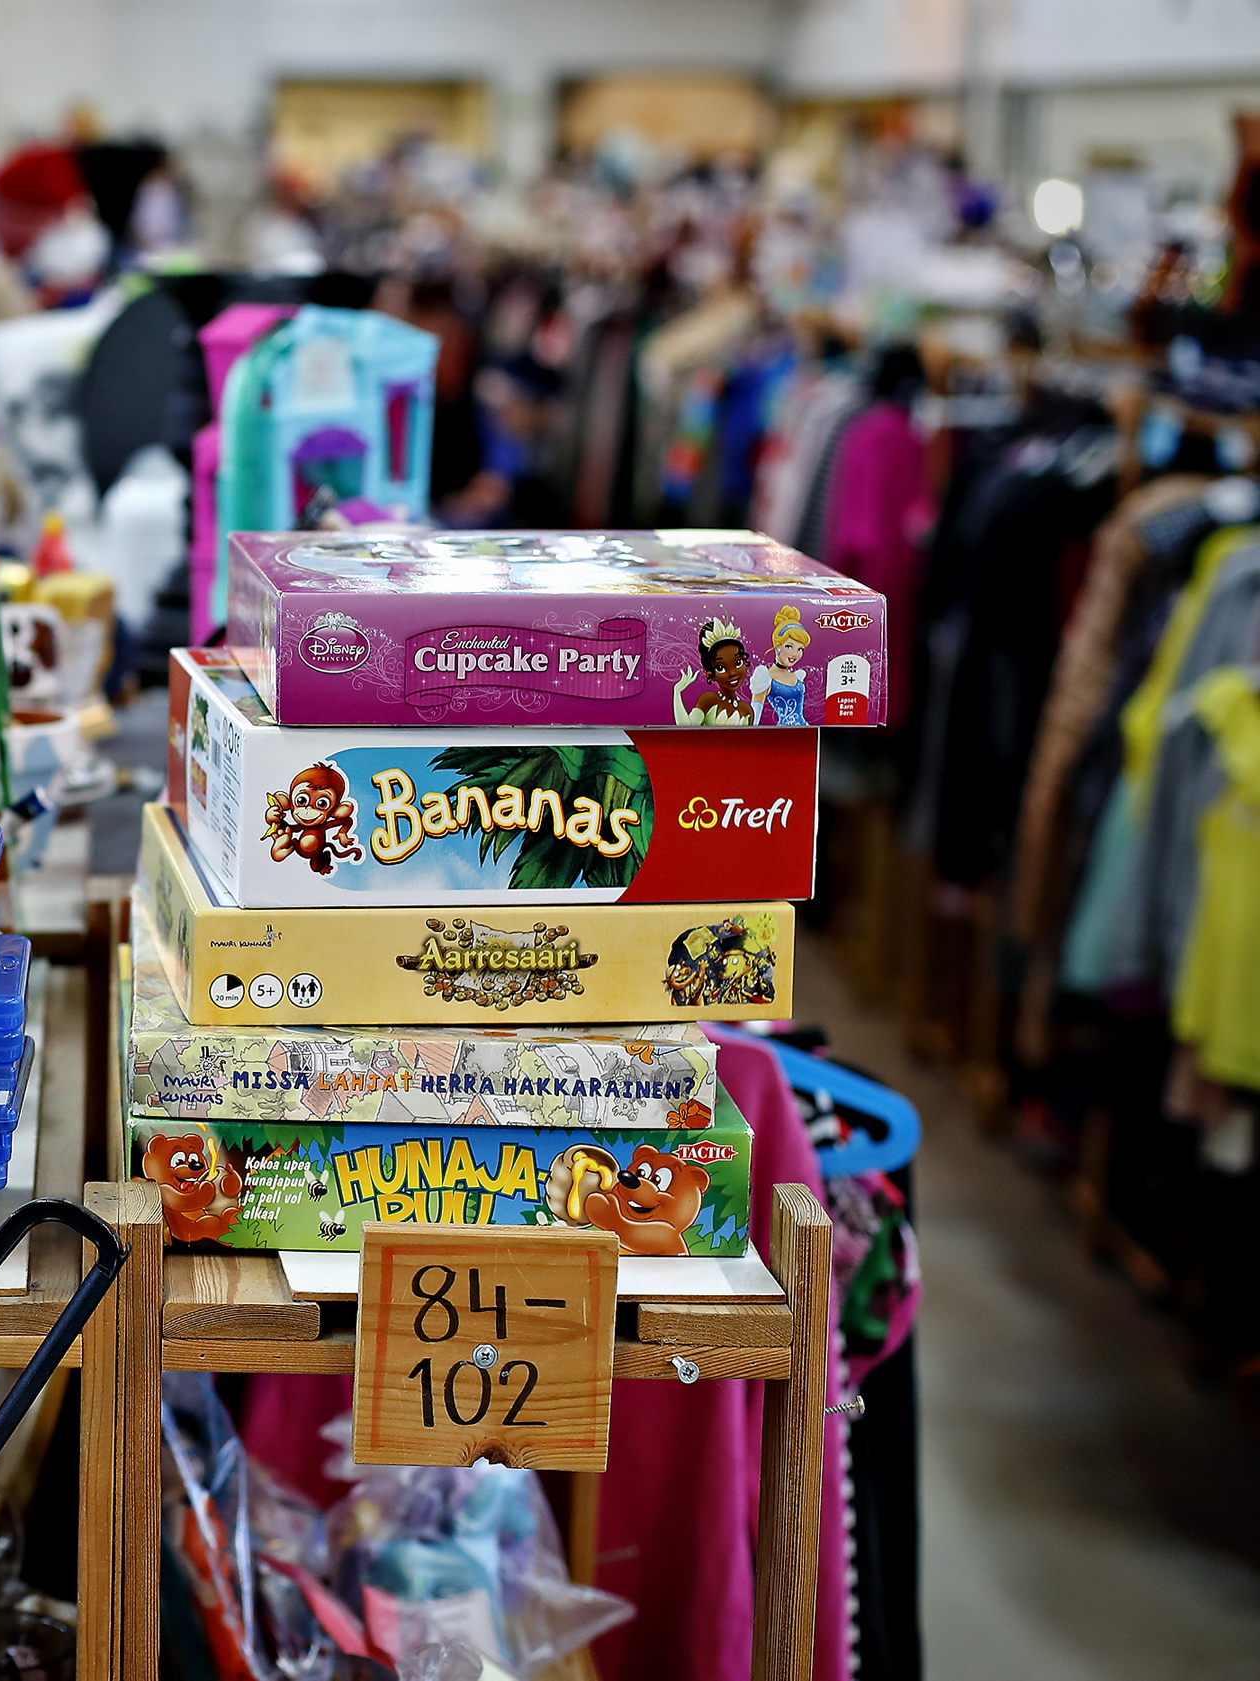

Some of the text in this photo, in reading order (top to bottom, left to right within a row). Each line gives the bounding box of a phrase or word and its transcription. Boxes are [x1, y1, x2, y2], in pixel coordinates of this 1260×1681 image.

[822, 615, 867, 626] TACTIC
[305, 635, 365, 661] Disney
[440, 631, 511, 650] Enchanted
[414, 646, 640, 680] Cupcake Party
[841, 675, 855, 686] 3+
[370, 768, 640, 864] Bananas
[720, 797, 793, 834] Trefl
[210, 940, 273, 948] MAURI KUNNAS
[418, 937, 579, 970] Aarresaari
[257, 984, 275, 997] 5+
[163, 1075, 217, 1088] MAURI
[232, 1067, 695, 1100] MISSÄ LAHJAT HERRA HAKKARAINEN?
[158, 1091, 224, 1105] KUNNAS
[681, 1146, 731, 1159] TACTIC
[245, 1156, 311, 1174] Kokoa upea
[244, 1173, 306, 1190] hunajapuu
[242, 1190, 303, 1206] ja peli voi
[243, 1206, 281, 1220] alkaa!
[408, 1358, 548, 1427] 102
